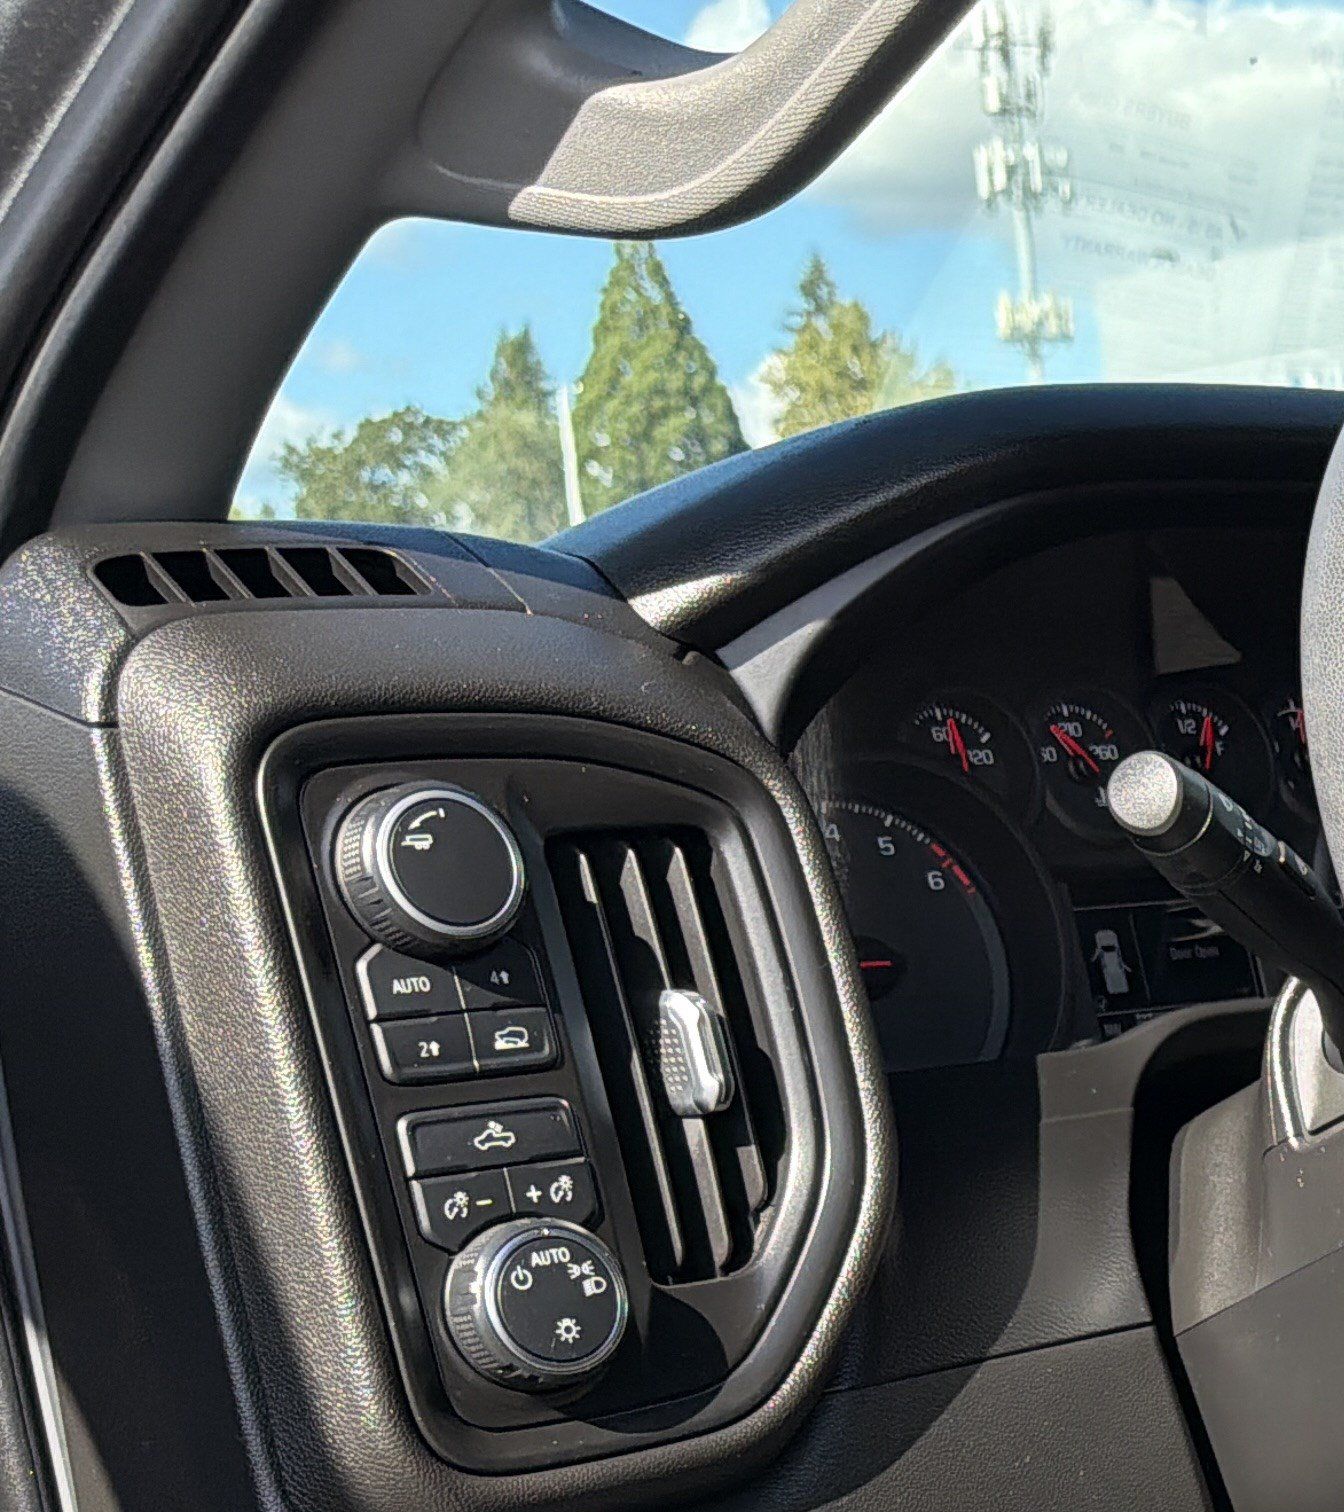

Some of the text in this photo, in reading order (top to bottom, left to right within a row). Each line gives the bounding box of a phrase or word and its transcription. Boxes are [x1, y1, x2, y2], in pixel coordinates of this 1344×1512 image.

[877, 835, 895, 856] 5
[926, 870, 946, 891] 6
[392, 976, 431, 994] AUTO
[530, 1246, 571, 1268] AUTO
